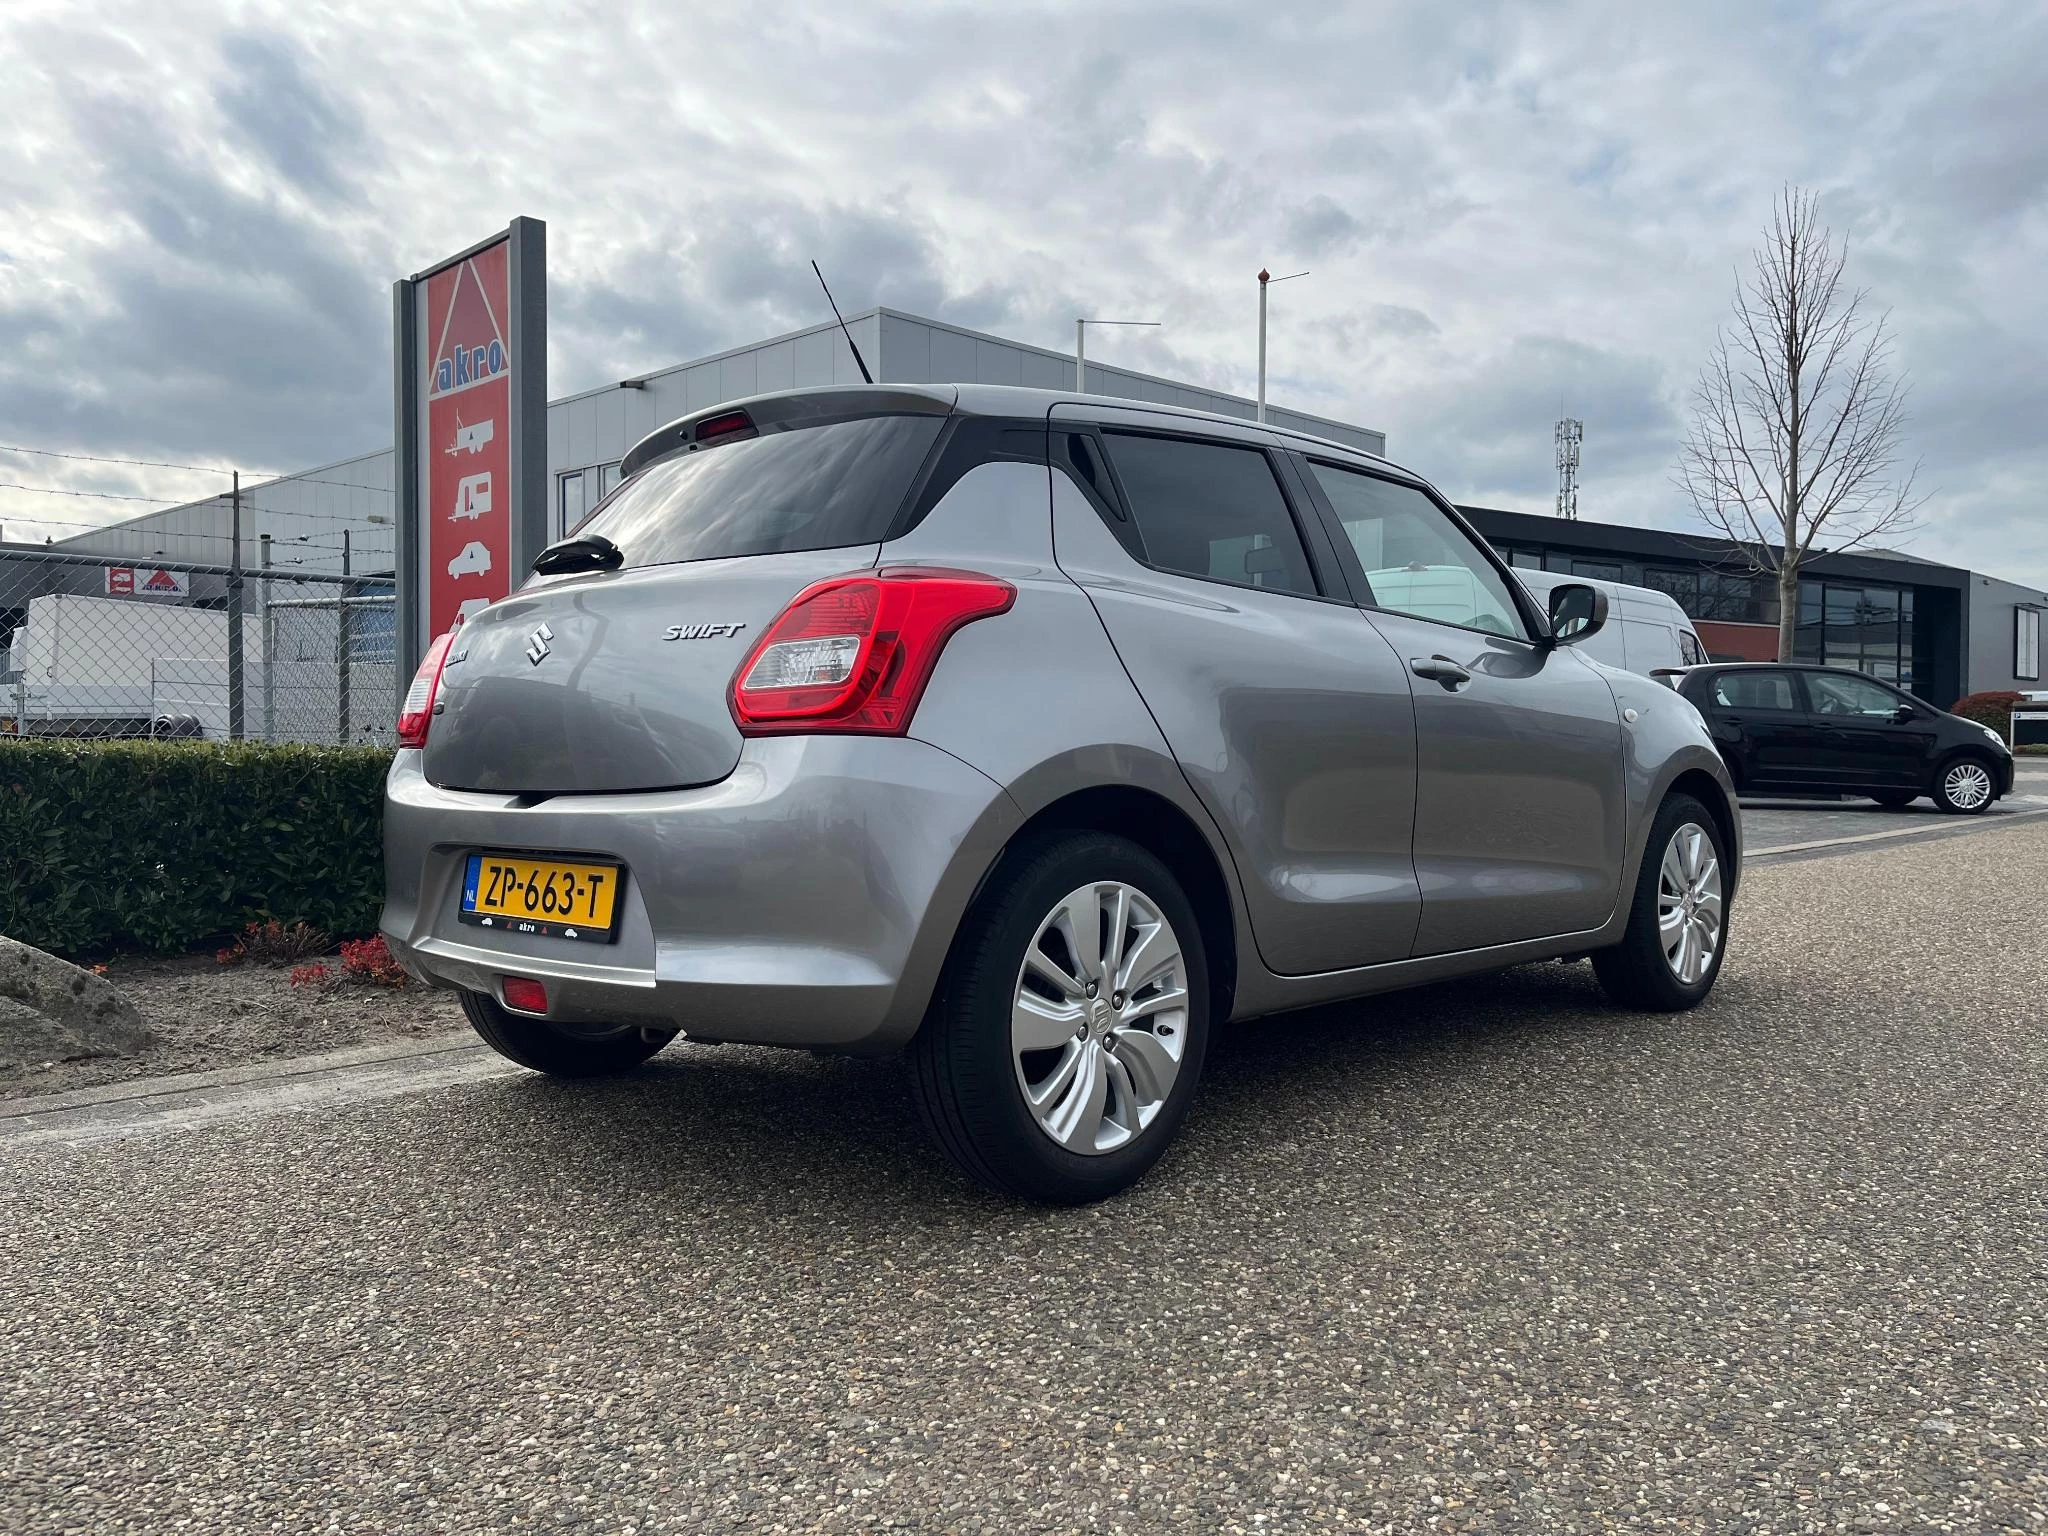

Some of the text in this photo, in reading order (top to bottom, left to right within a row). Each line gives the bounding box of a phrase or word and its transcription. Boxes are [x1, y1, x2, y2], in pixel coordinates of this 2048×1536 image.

[438, 339, 502, 391] akro
[662, 622, 746, 641] SWIFT
[466, 866, 604, 918] NL ZP-663-T
[519, 922, 535, 932] akro
